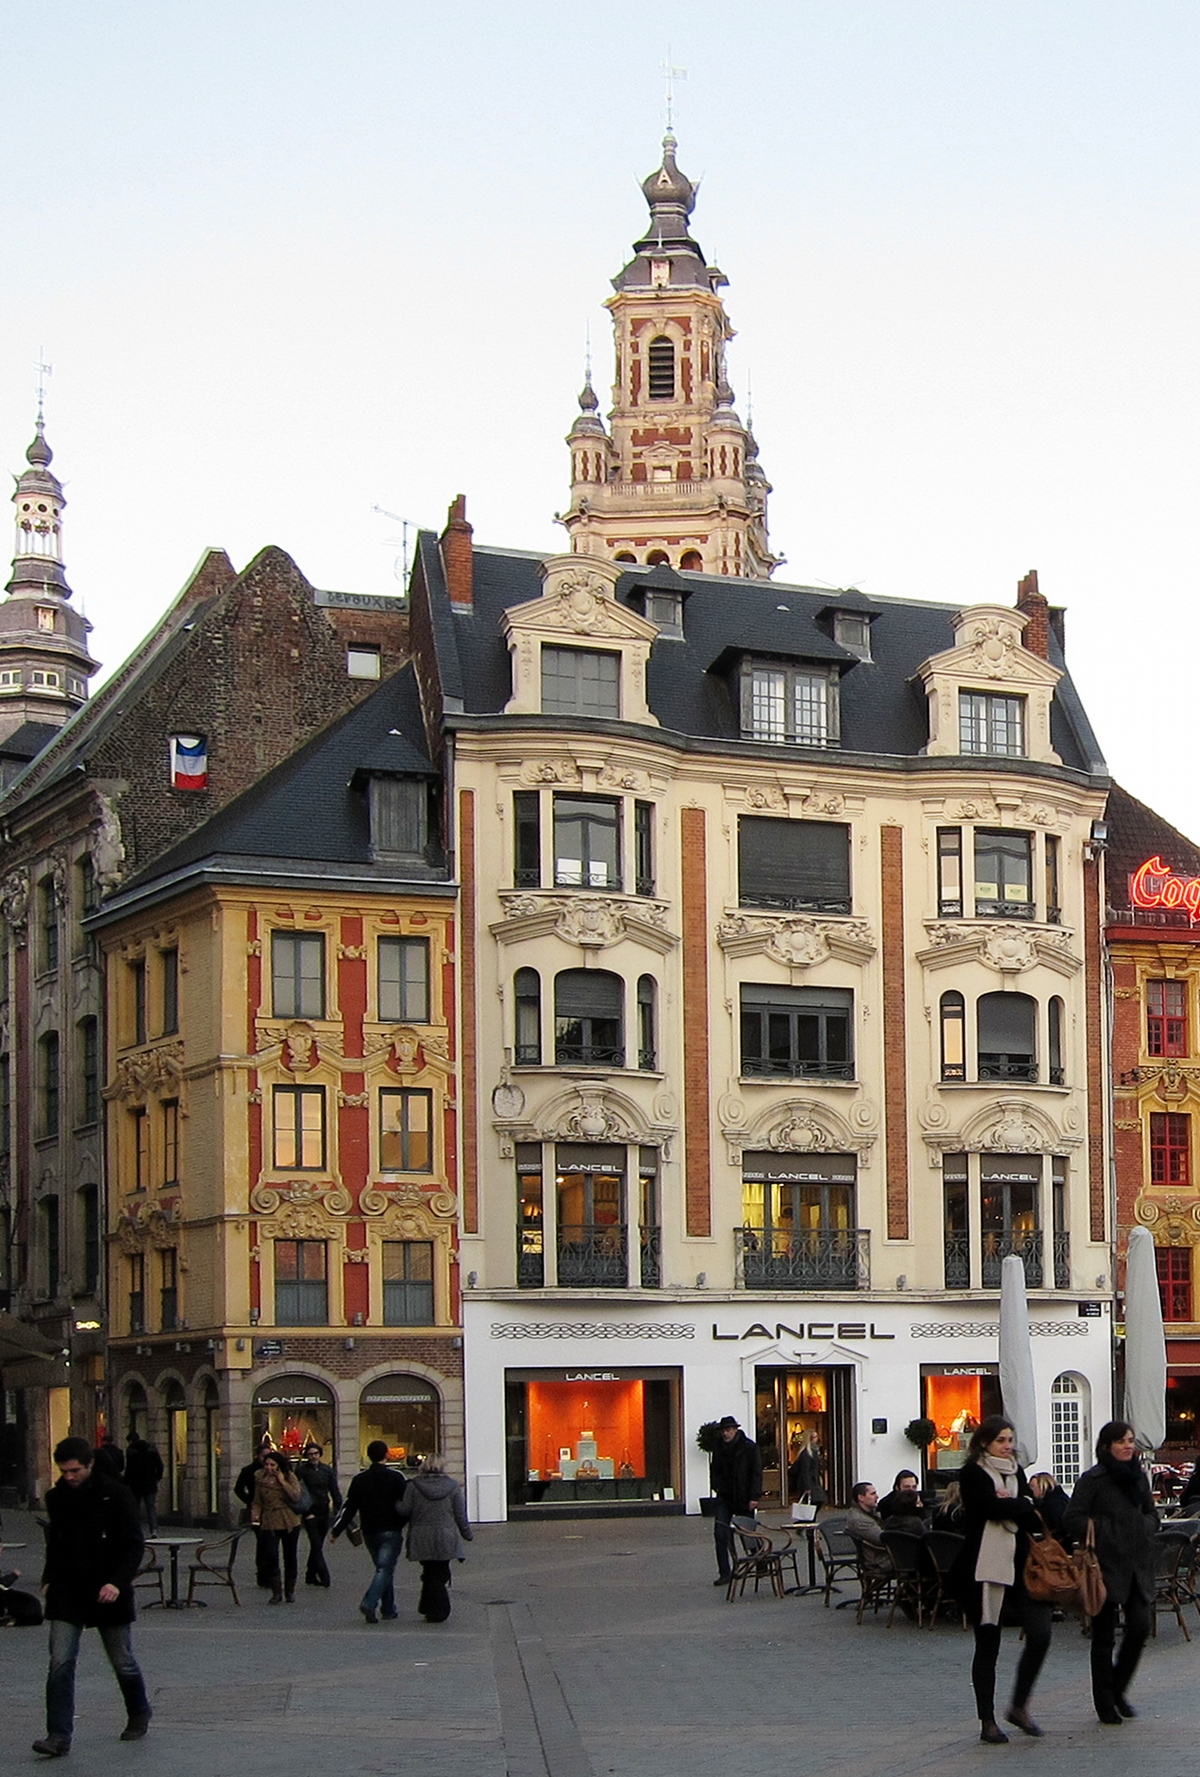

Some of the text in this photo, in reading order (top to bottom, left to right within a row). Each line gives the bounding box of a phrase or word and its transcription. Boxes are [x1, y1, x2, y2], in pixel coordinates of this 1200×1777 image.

[557, 1163, 623, 1172] LANCEL
[767, 1172, 829, 1180] LANCEL
[981, 1173, 1038, 1181] LANCEL
[712, 1323, 896, 1340] LANCEL
[943, 1367, 992, 1375] LANCEL
[565, 1373, 620, 1381] LANCEL
[257, 1396, 328, 1404] LANCEL
